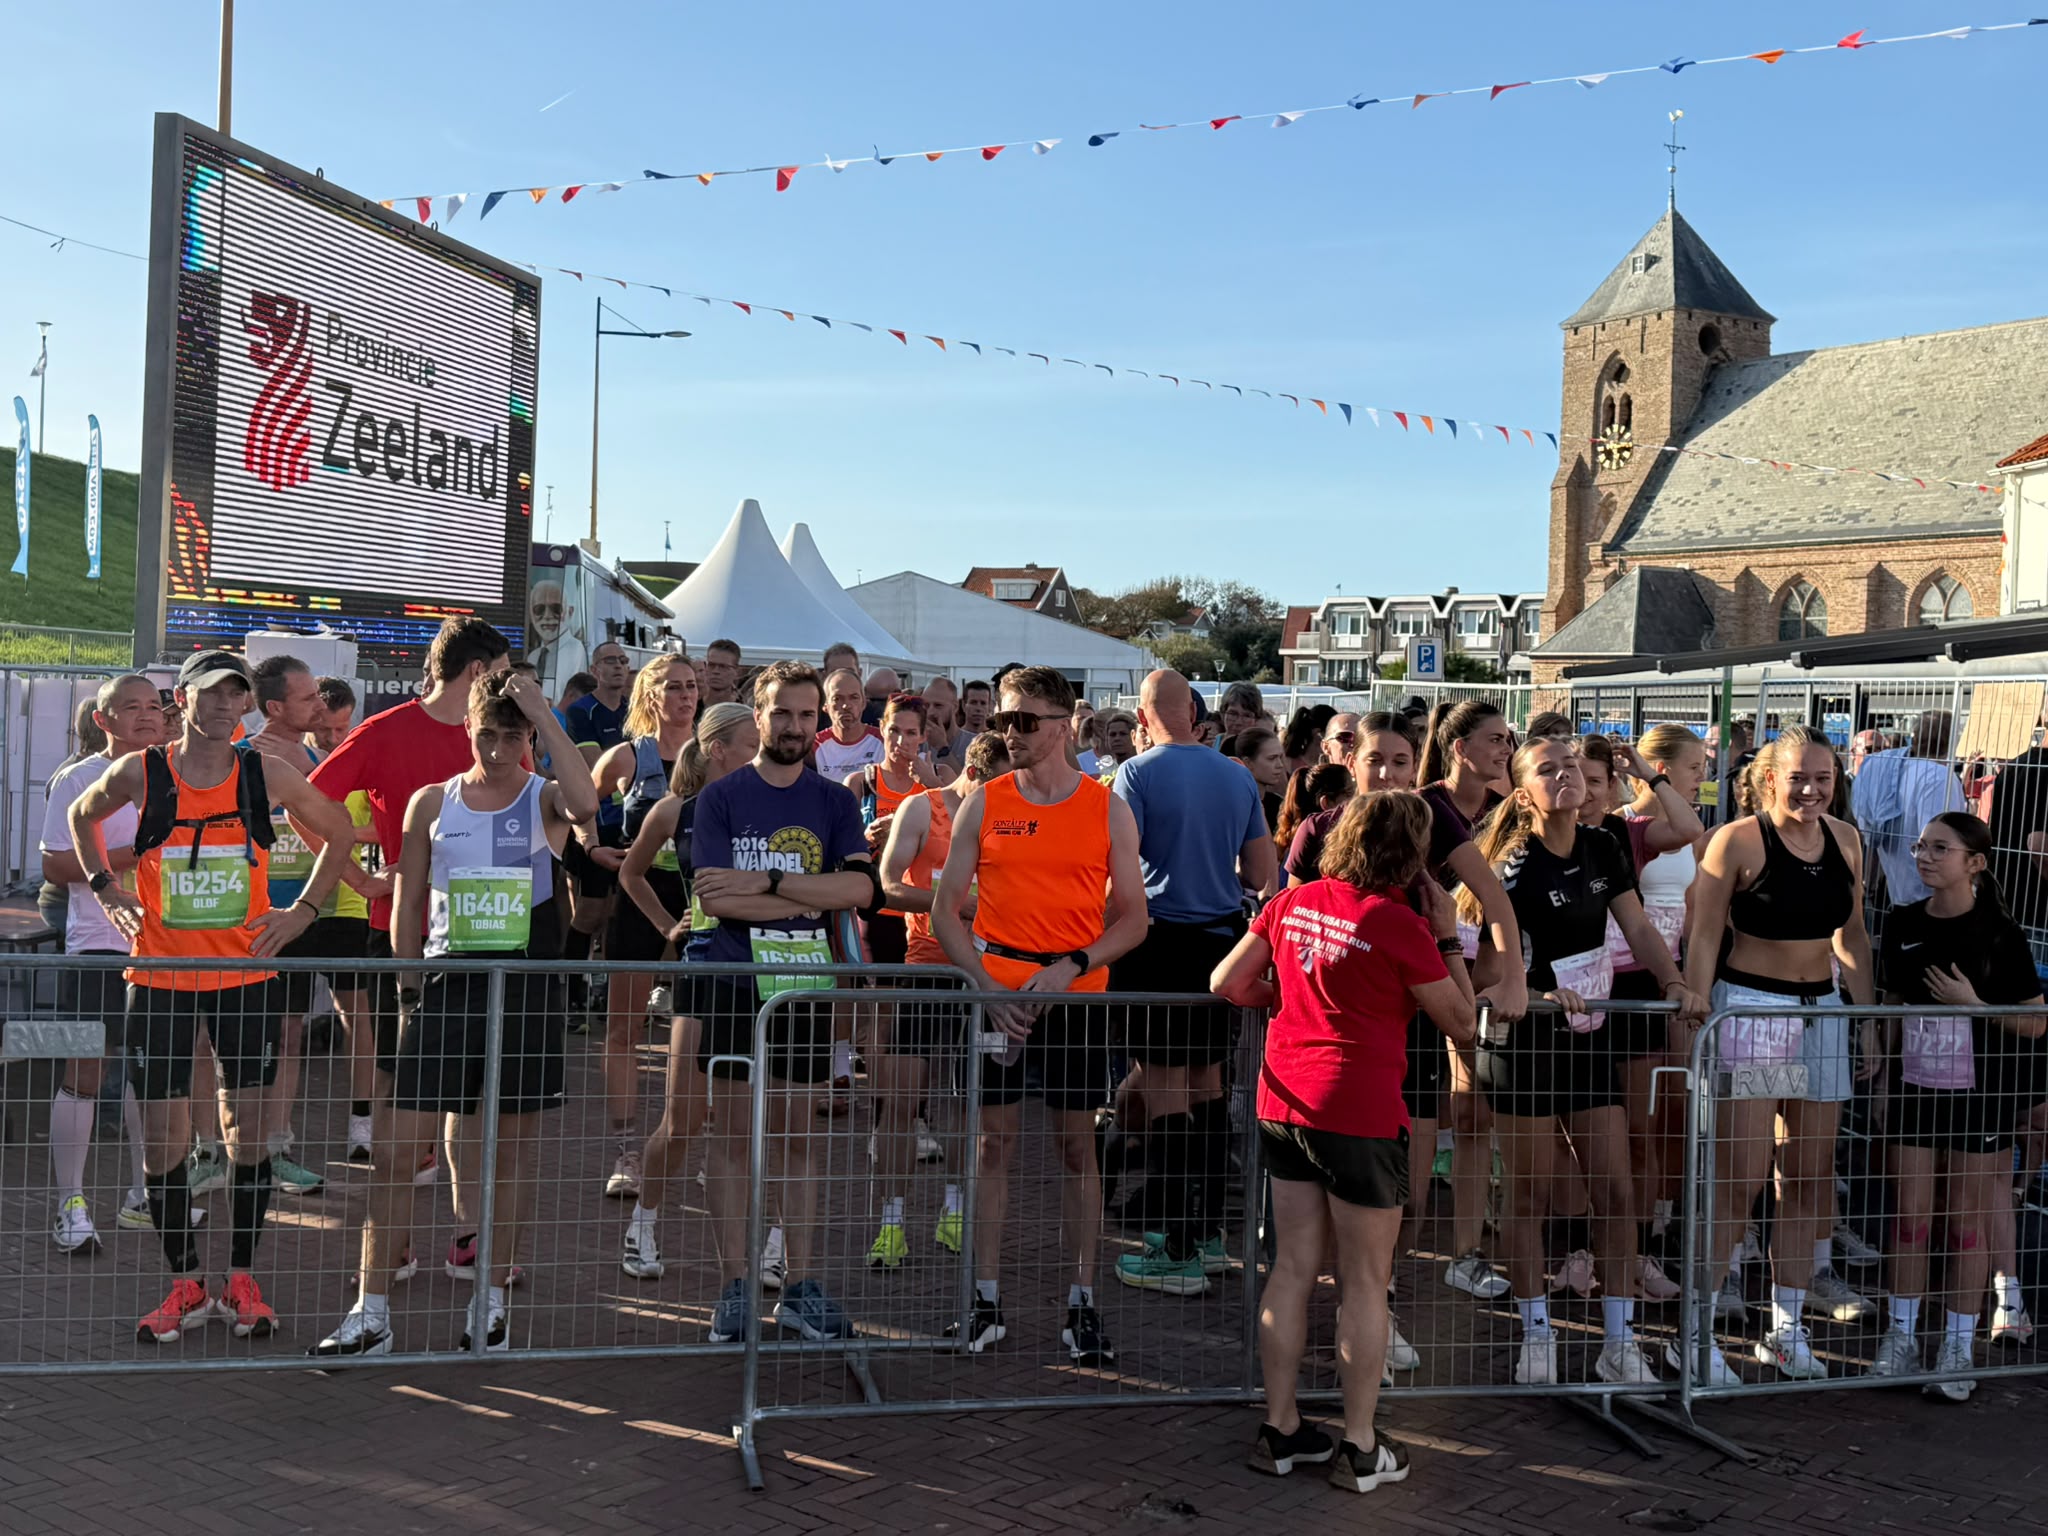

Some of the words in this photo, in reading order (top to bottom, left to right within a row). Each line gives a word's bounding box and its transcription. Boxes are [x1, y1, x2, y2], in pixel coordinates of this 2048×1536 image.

[327, 312, 436, 388] Provincie
[322, 380, 499, 499] Zeeland
[1421, 646, 1432, 661] P
[732, 837, 768, 851] 2016
[273, 855, 296, 863] PETER
[732, 850, 805, 875] WANDEL
[168, 870, 244, 896] 16254
[193, 898, 219, 908] OLOF
[453, 892, 526, 917] 16404
[470, 919, 506, 930] TOBIAS
[1293, 905, 1358, 933] ORGANISATIE
[1281, 916, 1322, 934] ADIESRUN
[1324, 927, 1372, 952] TRAILRUN
[1735, 1069, 1806, 1096] RVV
